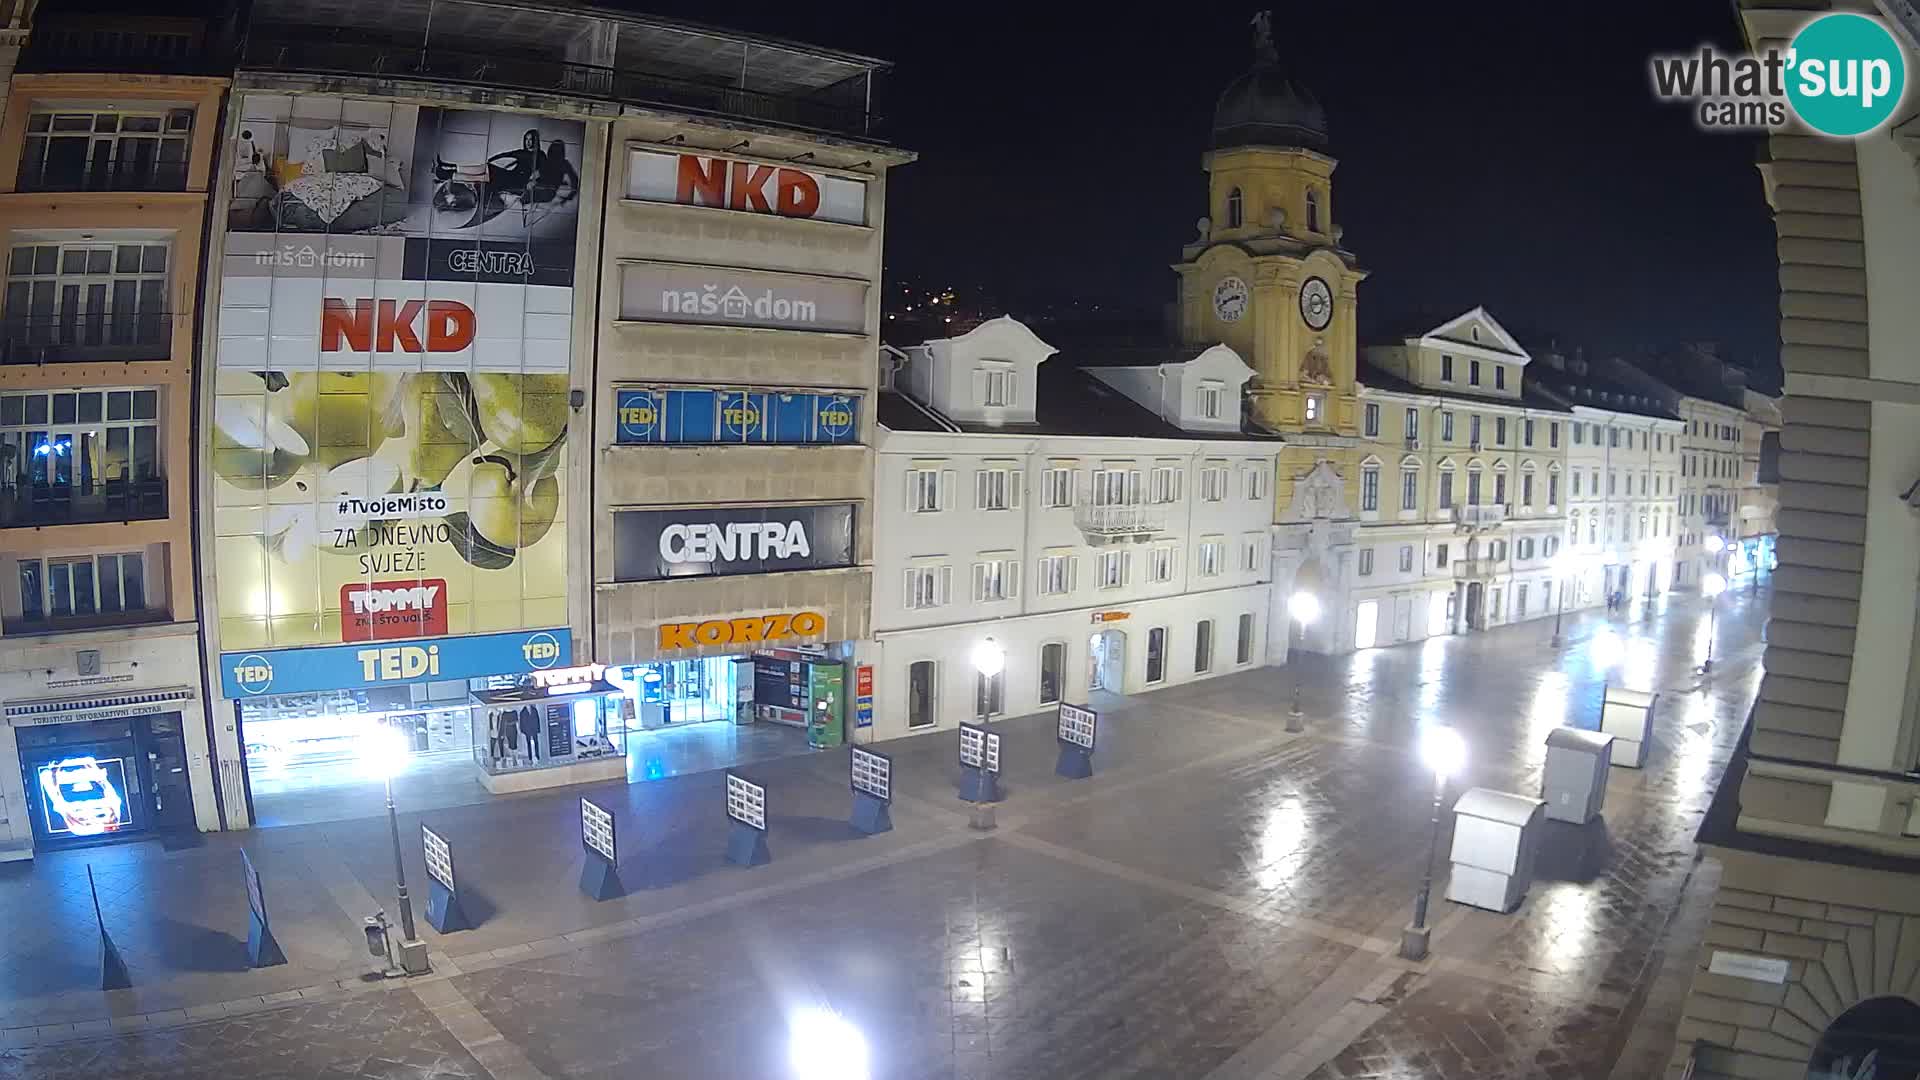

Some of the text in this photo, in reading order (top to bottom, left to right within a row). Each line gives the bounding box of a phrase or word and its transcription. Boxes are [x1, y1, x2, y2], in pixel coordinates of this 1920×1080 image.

[676, 154, 820, 218] NKD
[320, 248, 365, 267] dom
[449, 249, 535, 275] CENTRA
[662, 284, 816, 322] naš dom
[320, 297, 477, 353] NKD
[619, 408, 658, 424] TEDi
[820, 411, 853, 426] TEDi
[339, 496, 446, 516] #TvojeMisto
[334, 523, 450, 548] ZA DNEVNO
[659, 520, 810, 564] CENTRA
[360, 546, 427, 575] SVJEŽE
[348, 586, 439, 614] TOMMY
[659, 611, 826, 650] KORZO
[358, 644, 439, 682] TEDi
[522, 641, 560, 661] TEDi
[234, 665, 274, 684] TEDi
